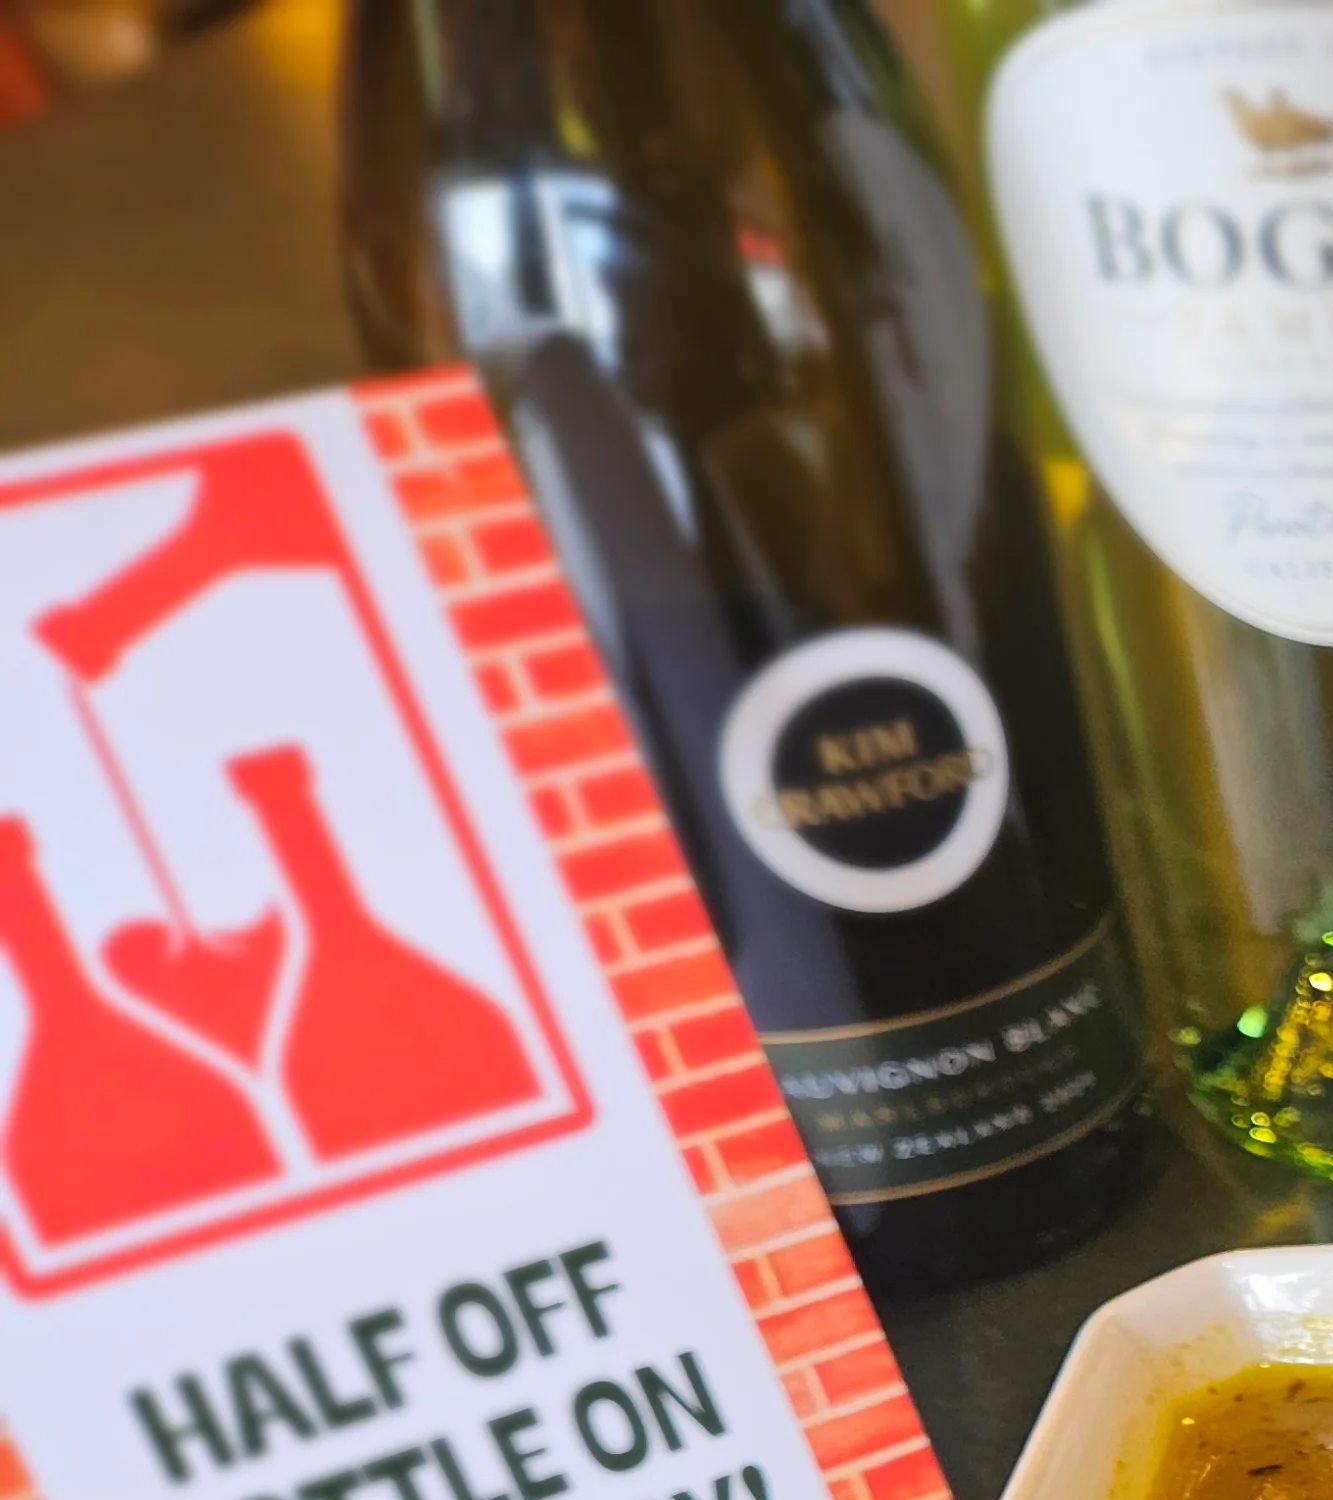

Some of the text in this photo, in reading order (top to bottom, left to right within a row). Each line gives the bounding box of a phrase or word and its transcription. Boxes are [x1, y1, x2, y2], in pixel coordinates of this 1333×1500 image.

[127, 1241, 623, 1487] HALF OFF
[573, 1351, 727, 1473] ON
